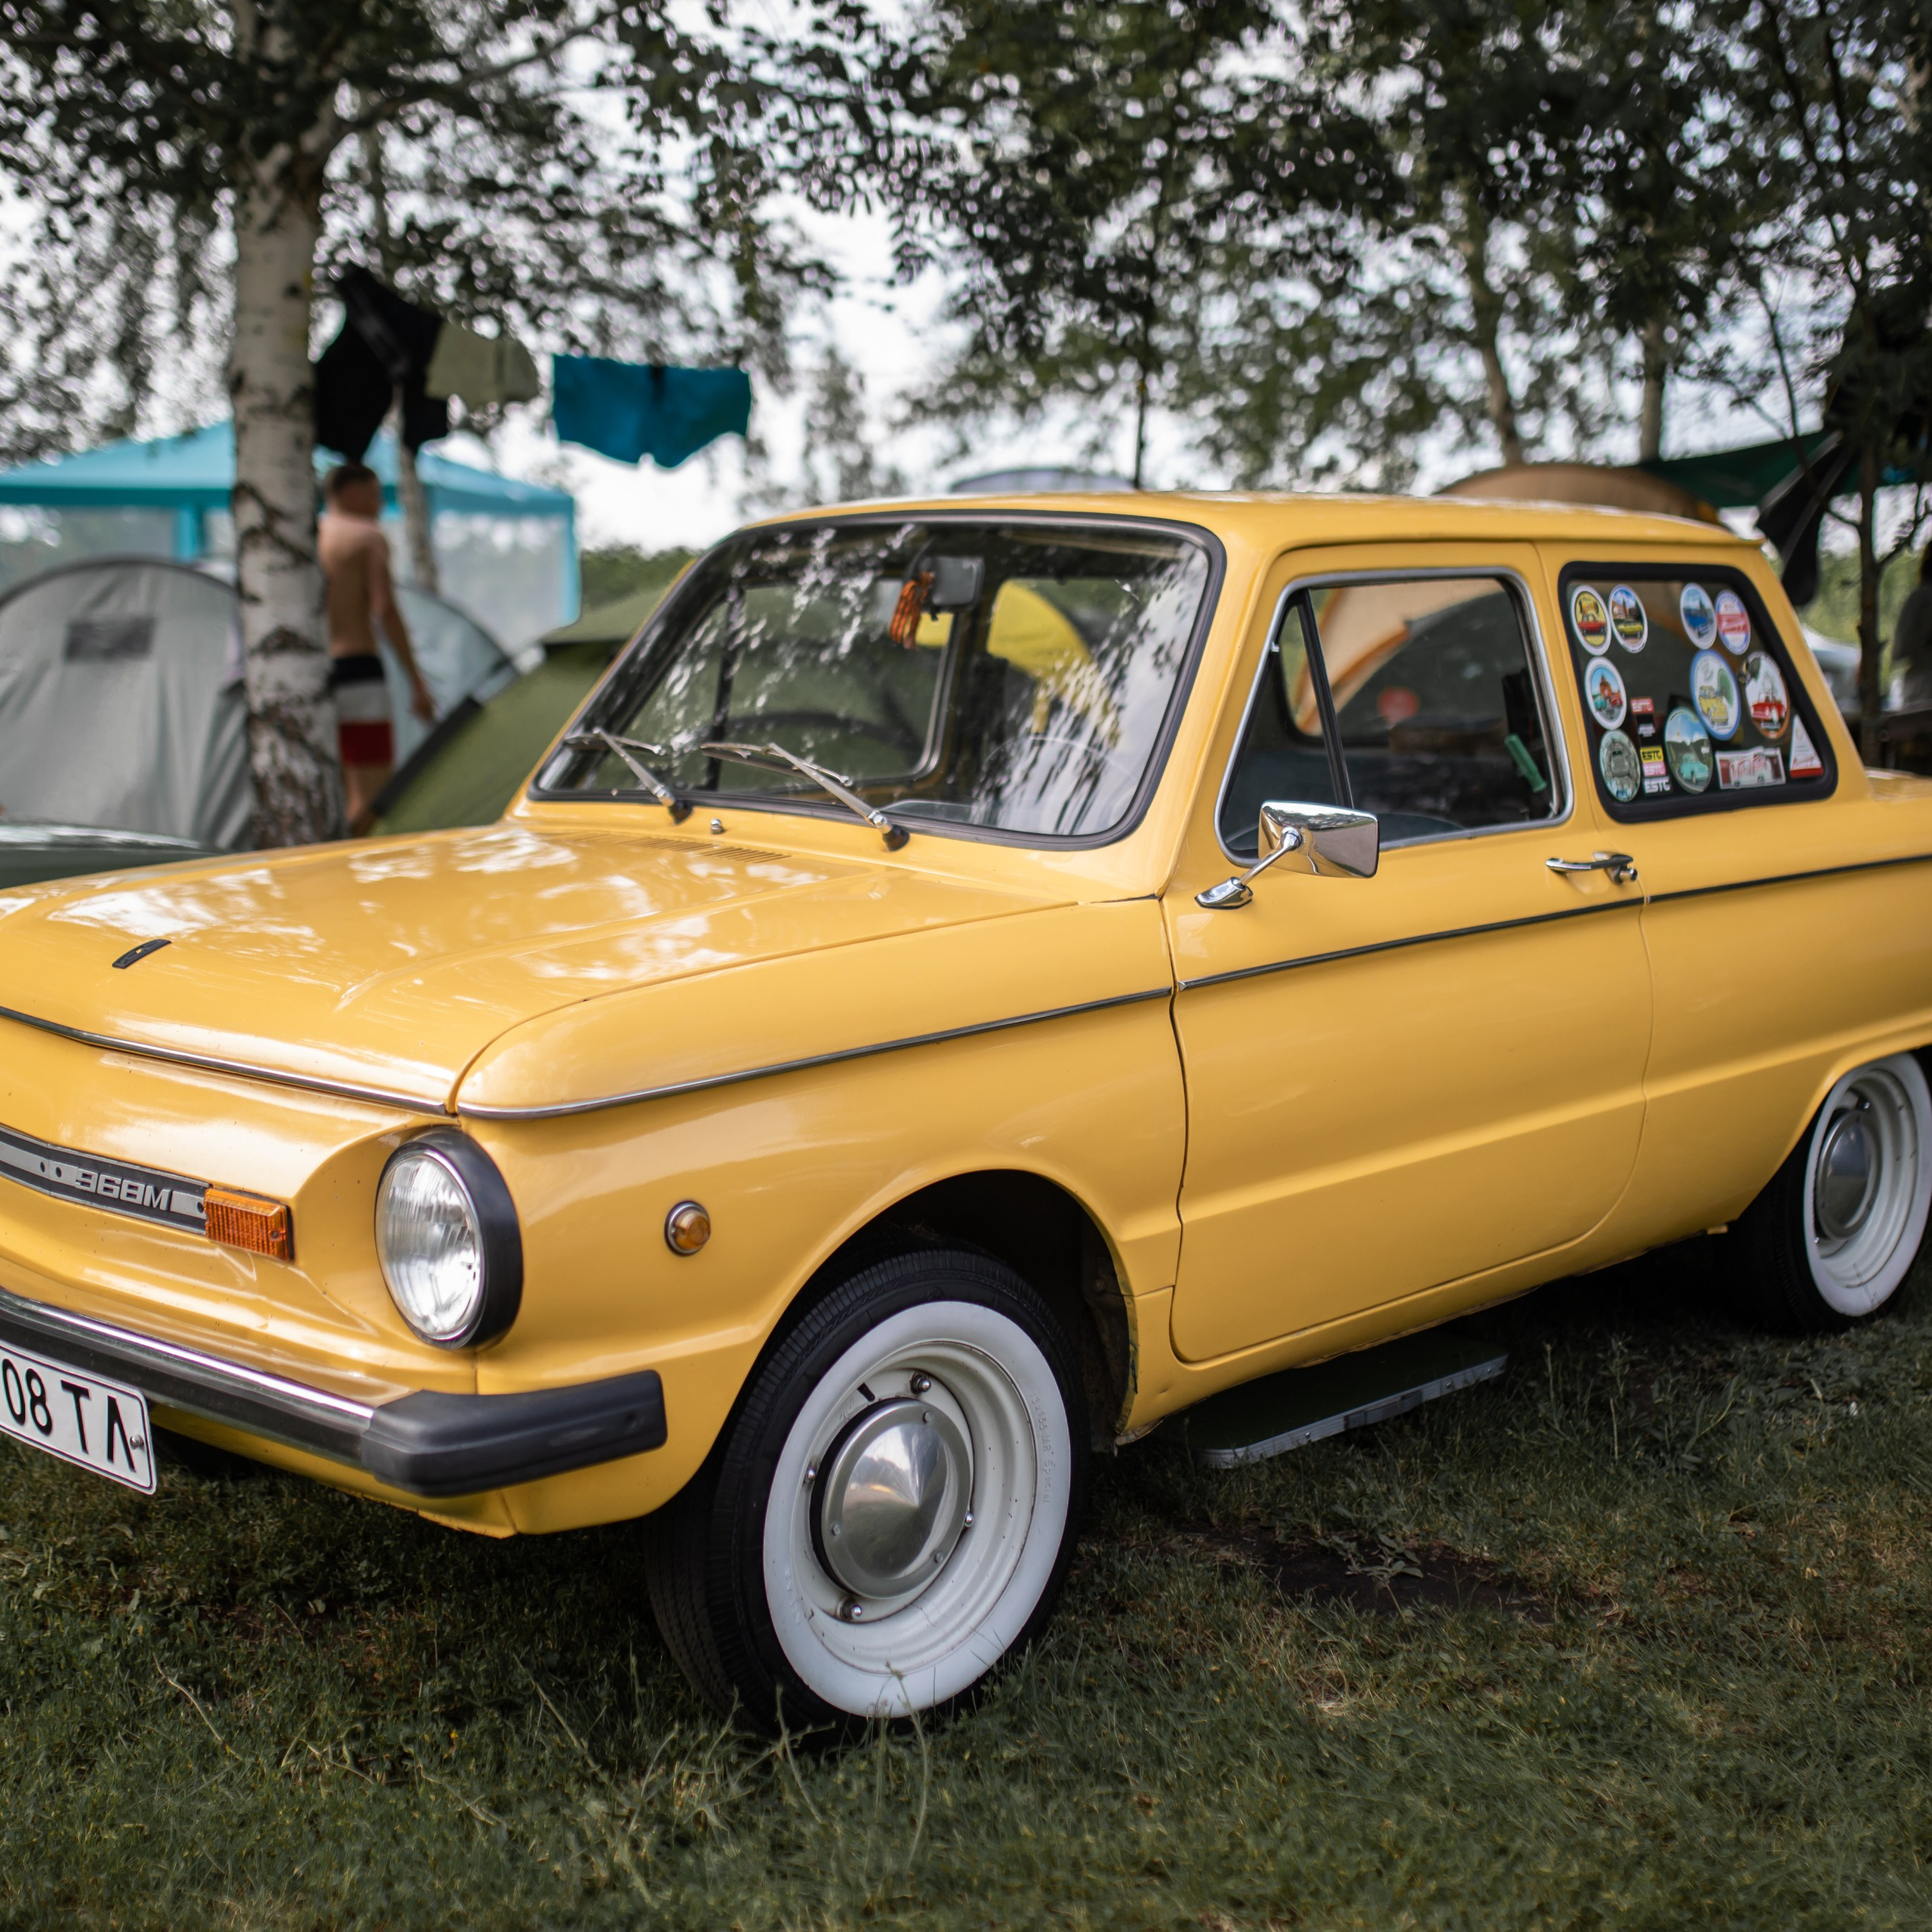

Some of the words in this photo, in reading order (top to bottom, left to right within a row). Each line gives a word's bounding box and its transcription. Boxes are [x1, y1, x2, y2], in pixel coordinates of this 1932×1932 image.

[75, 1168, 171, 1211] 968М
[2, 1362, 53, 1436] 08
[1042, 1460, 1054, 1503] Special
